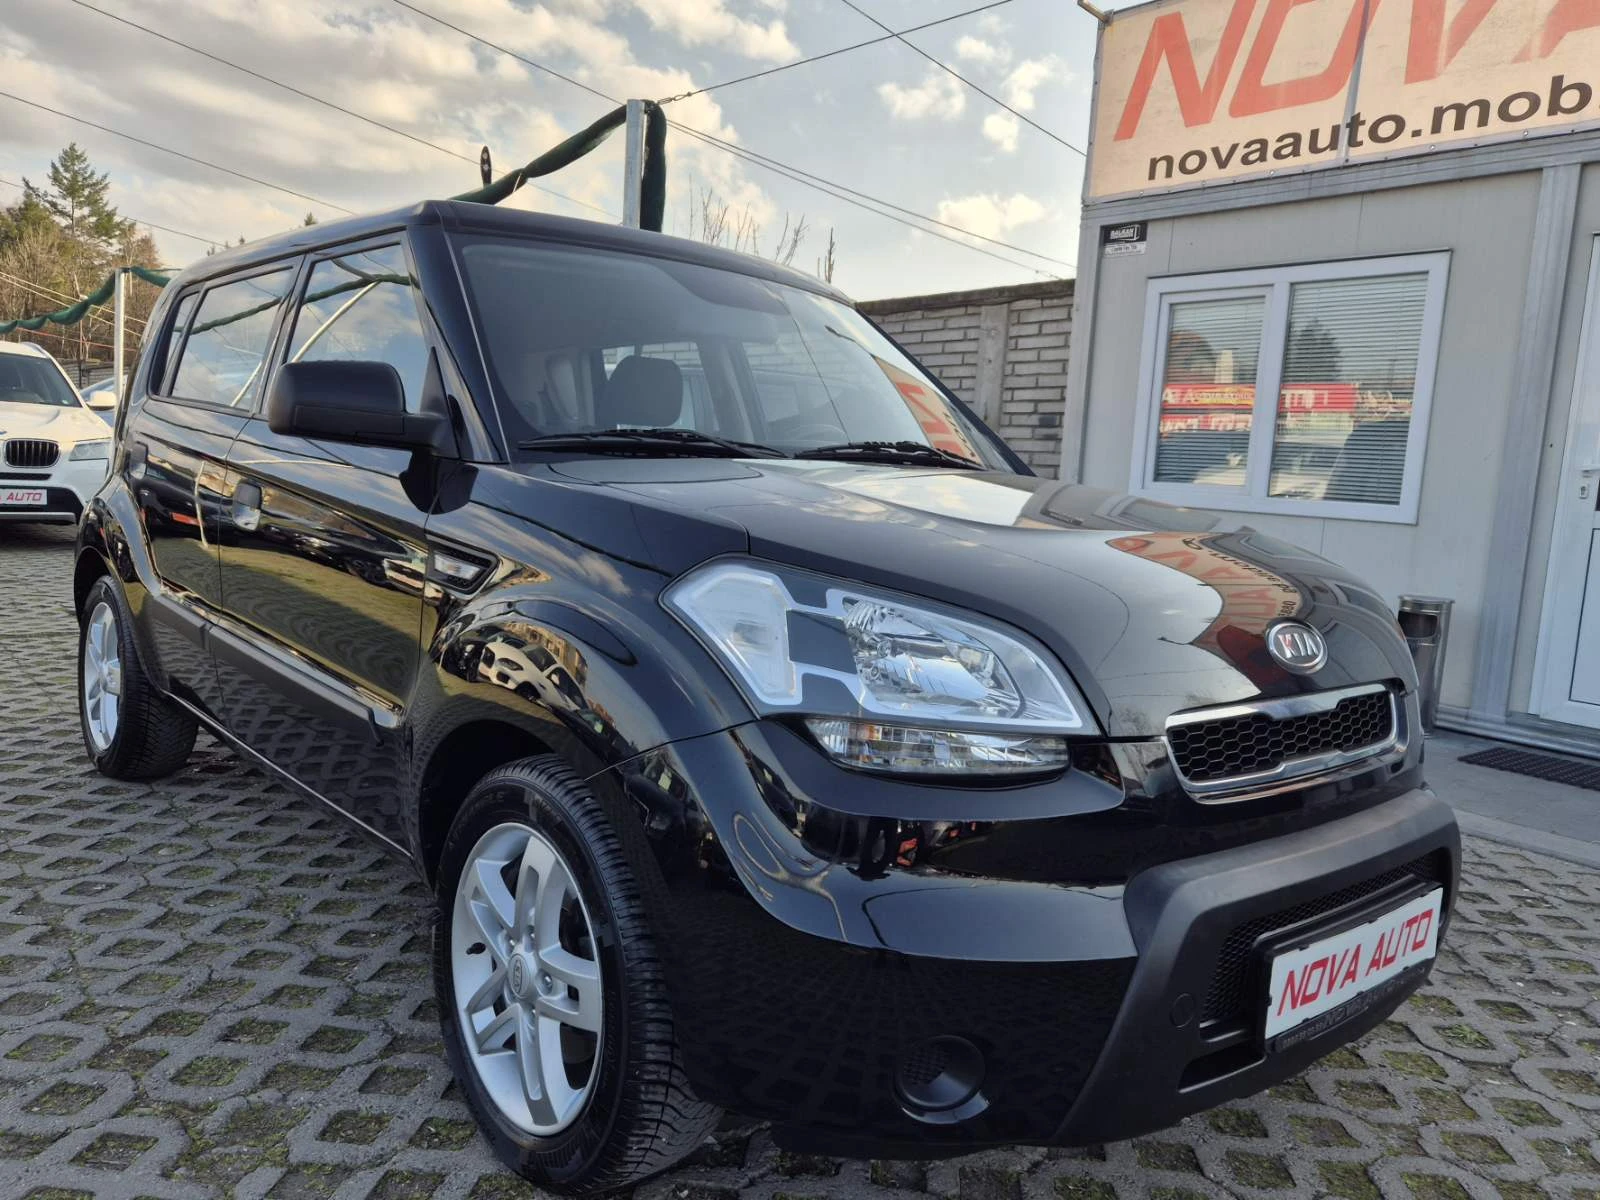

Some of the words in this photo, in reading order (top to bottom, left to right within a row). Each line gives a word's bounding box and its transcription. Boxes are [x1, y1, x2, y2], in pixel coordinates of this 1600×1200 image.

[1148, 75, 1597, 181] novaauto.mob
[6, 492, 42, 502] AUTO
[1278, 632, 1319, 659] KIA
[1277, 943, 1362, 1017] NOVA
[1365, 908, 1434, 977] AUTO
